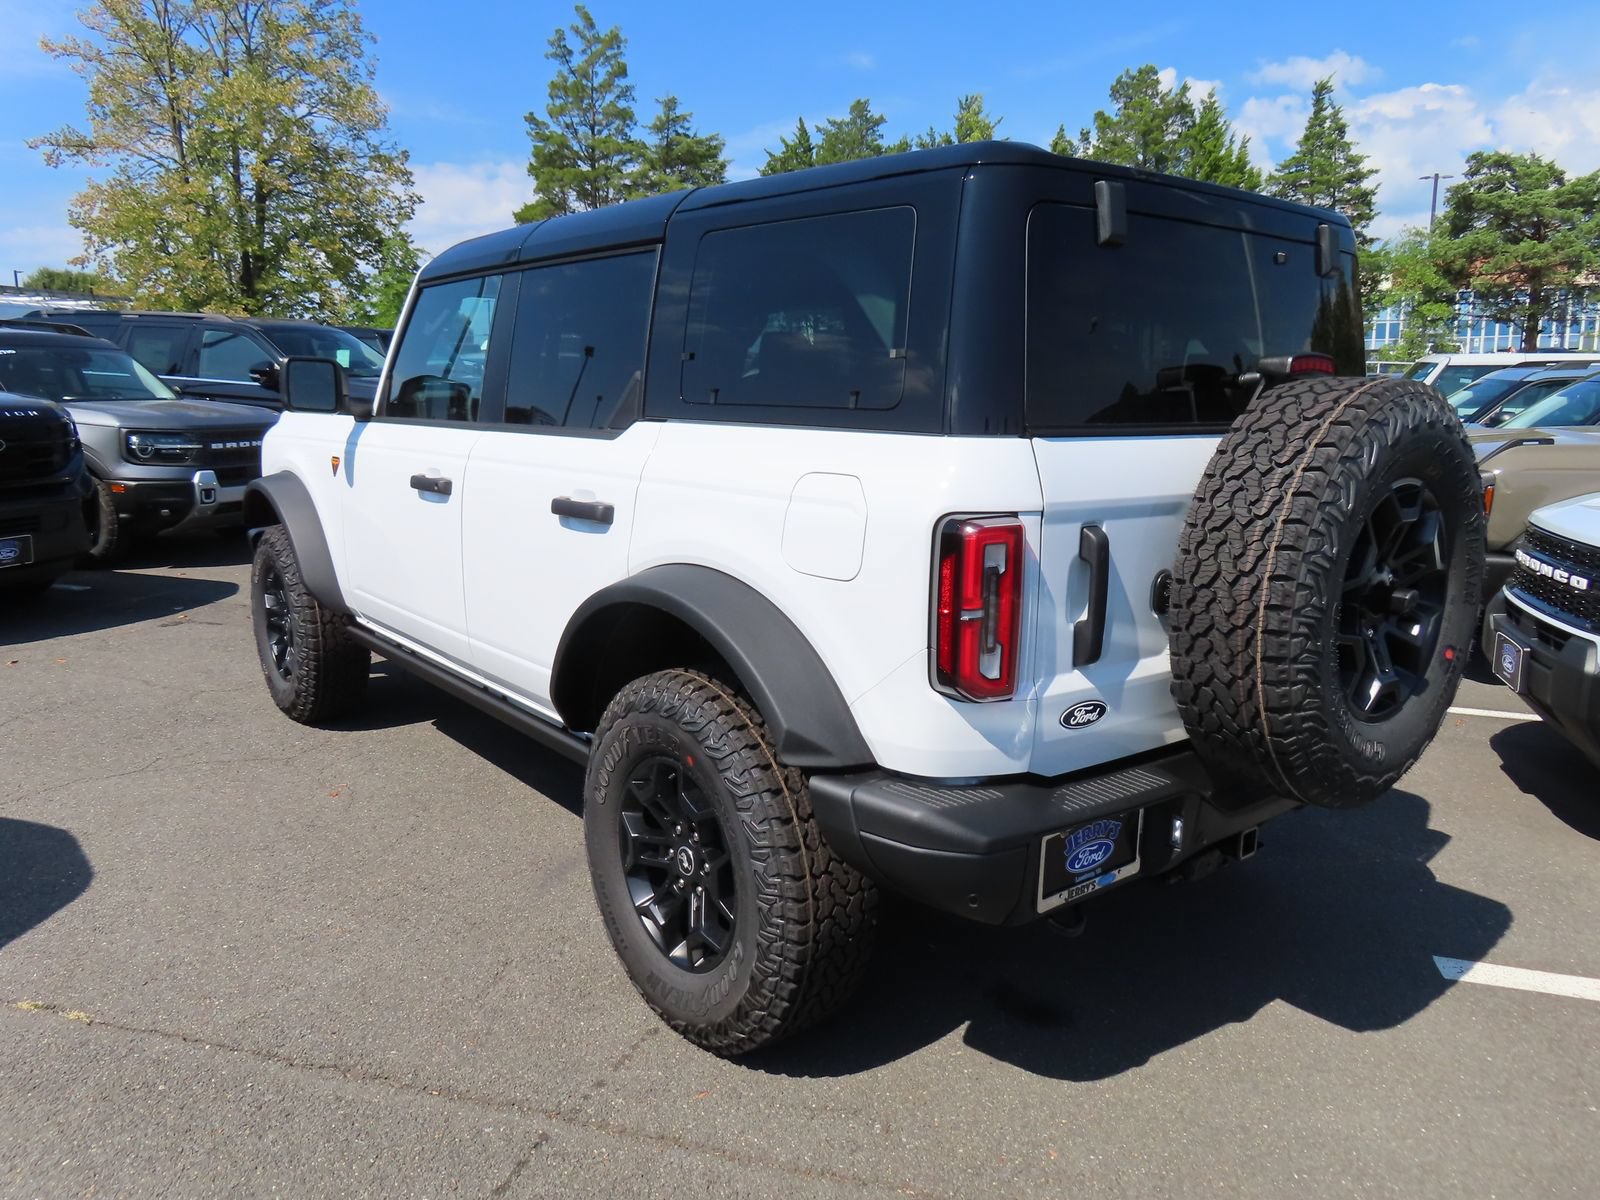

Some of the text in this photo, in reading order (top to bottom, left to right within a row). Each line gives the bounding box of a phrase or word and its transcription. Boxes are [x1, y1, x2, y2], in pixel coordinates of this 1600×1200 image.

[1515, 549, 1588, 590] BRONCO
[1069, 704, 1100, 726] Ford
[1073, 844, 1106, 869] Ford
